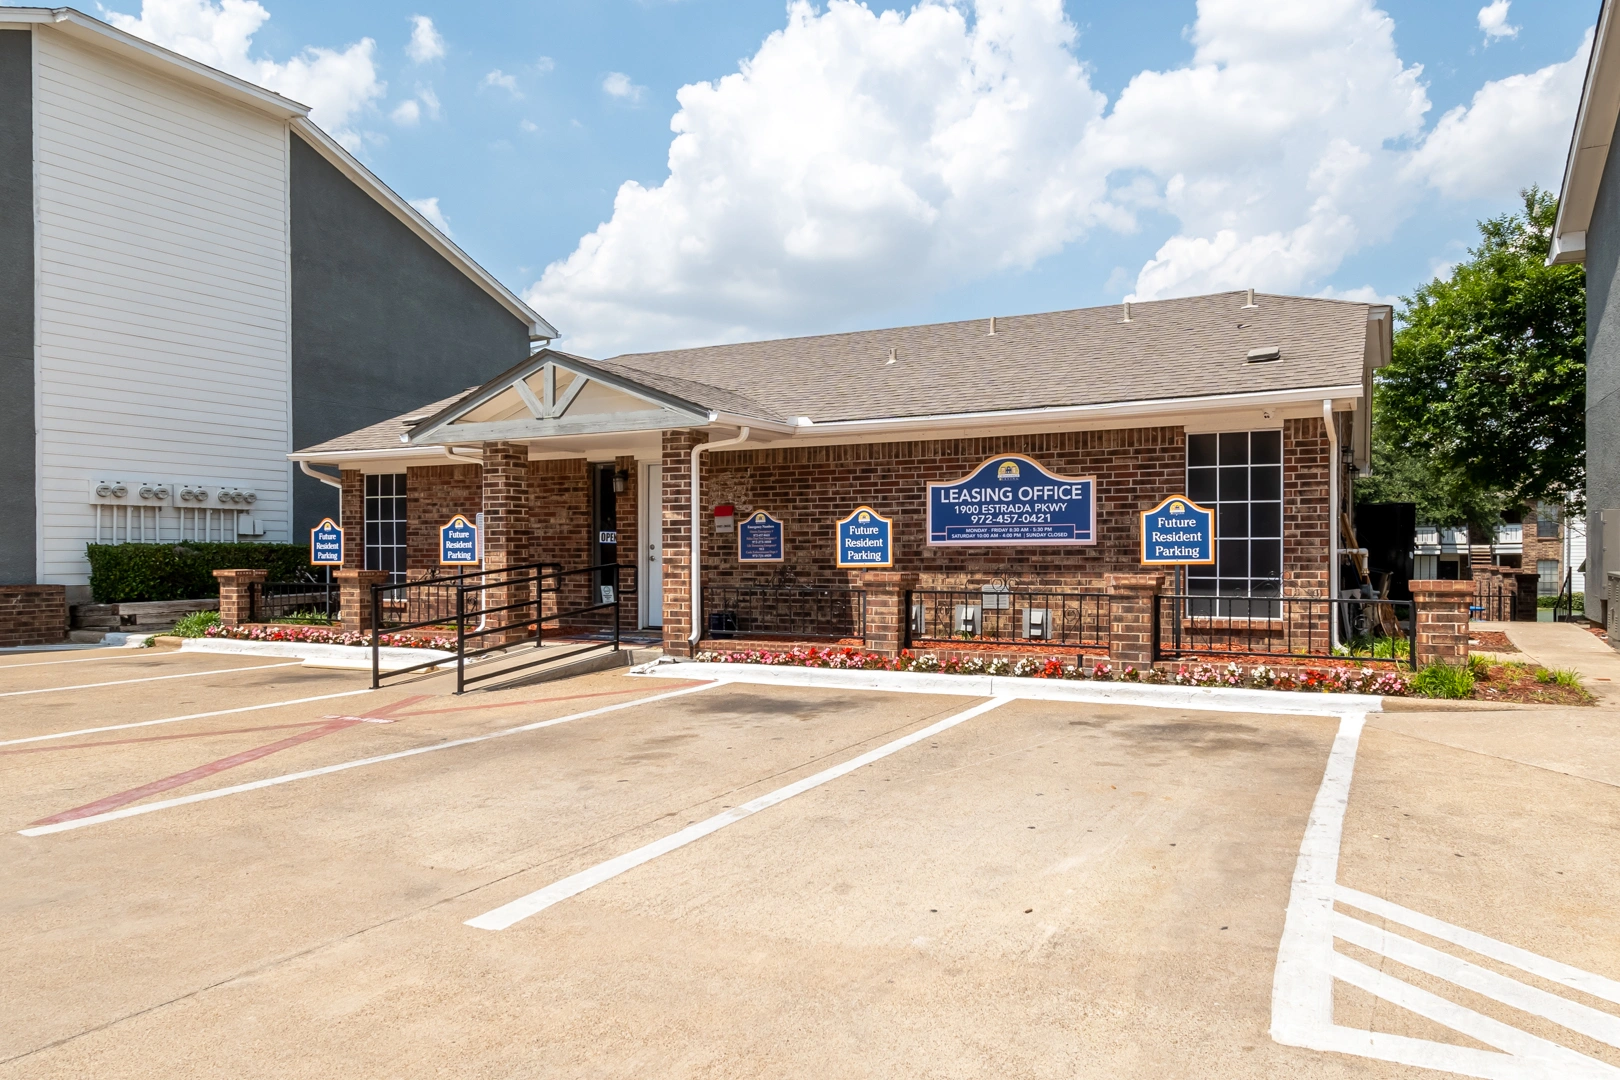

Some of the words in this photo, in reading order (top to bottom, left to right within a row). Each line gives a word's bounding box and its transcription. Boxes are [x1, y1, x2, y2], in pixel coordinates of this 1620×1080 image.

[940, 487, 1013, 503] LEASING
[1018, 485, 1083, 501] OFFICE
[954, 505, 979, 514] 1900
[982, 503, 1032, 514] ESTRADA
[1034, 502, 1068, 512] PKWY
[971, 513, 1051, 524] 972-457-0421
[1158, 518, 1196, 528] Future
[448, 530, 470, 538] Future
[849, 525, 879, 535] Future
[1152, 531, 1202, 542] Resident
[446, 540, 472, 548] Resident
[845, 538, 884, 548] Resident
[318, 552, 338, 560] Parking
[448, 550, 472, 560] Parking
[848, 550, 882, 562] Parking
[1155, 546, 1200, 558] Parking
